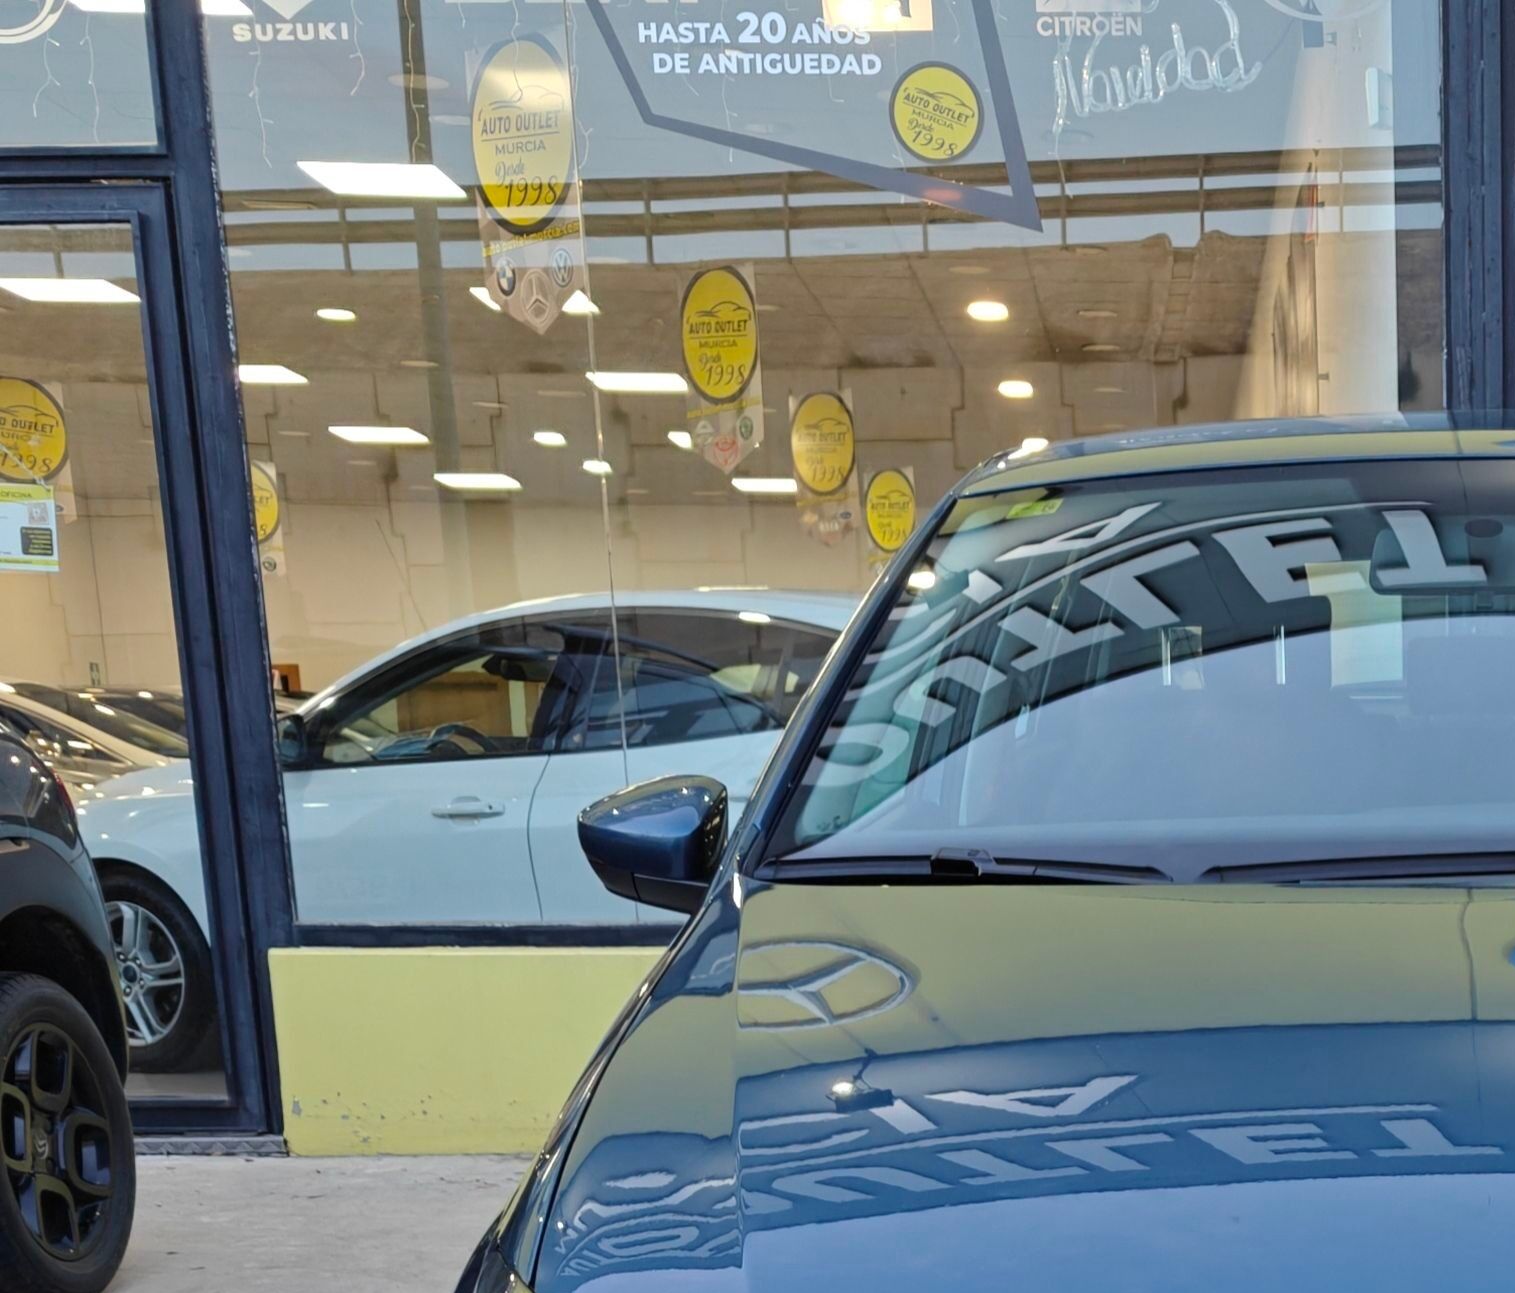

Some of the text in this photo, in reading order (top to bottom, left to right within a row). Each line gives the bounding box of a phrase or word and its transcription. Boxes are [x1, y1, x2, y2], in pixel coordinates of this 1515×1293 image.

[232, 22, 349, 42] SUZUKI
[637, 11, 871, 45] HASTA 20 AÑOS
[1036, 12, 1142, 37] CITROËN
[652, 52, 882, 76] DE ANTIGUEDAD
[903, 92, 970, 124] AUTO OUTLET
[481, 110, 562, 136] AUTO OUTLET
[494, 138, 546, 156] MURCIA
[912, 130, 959, 156] 1998
[505, 174, 558, 208] 1998
[688, 319, 748, 334] AUTO OUTLET
[706, 364, 746, 387] 1998
[11, 418, 54, 433] OUTLET
